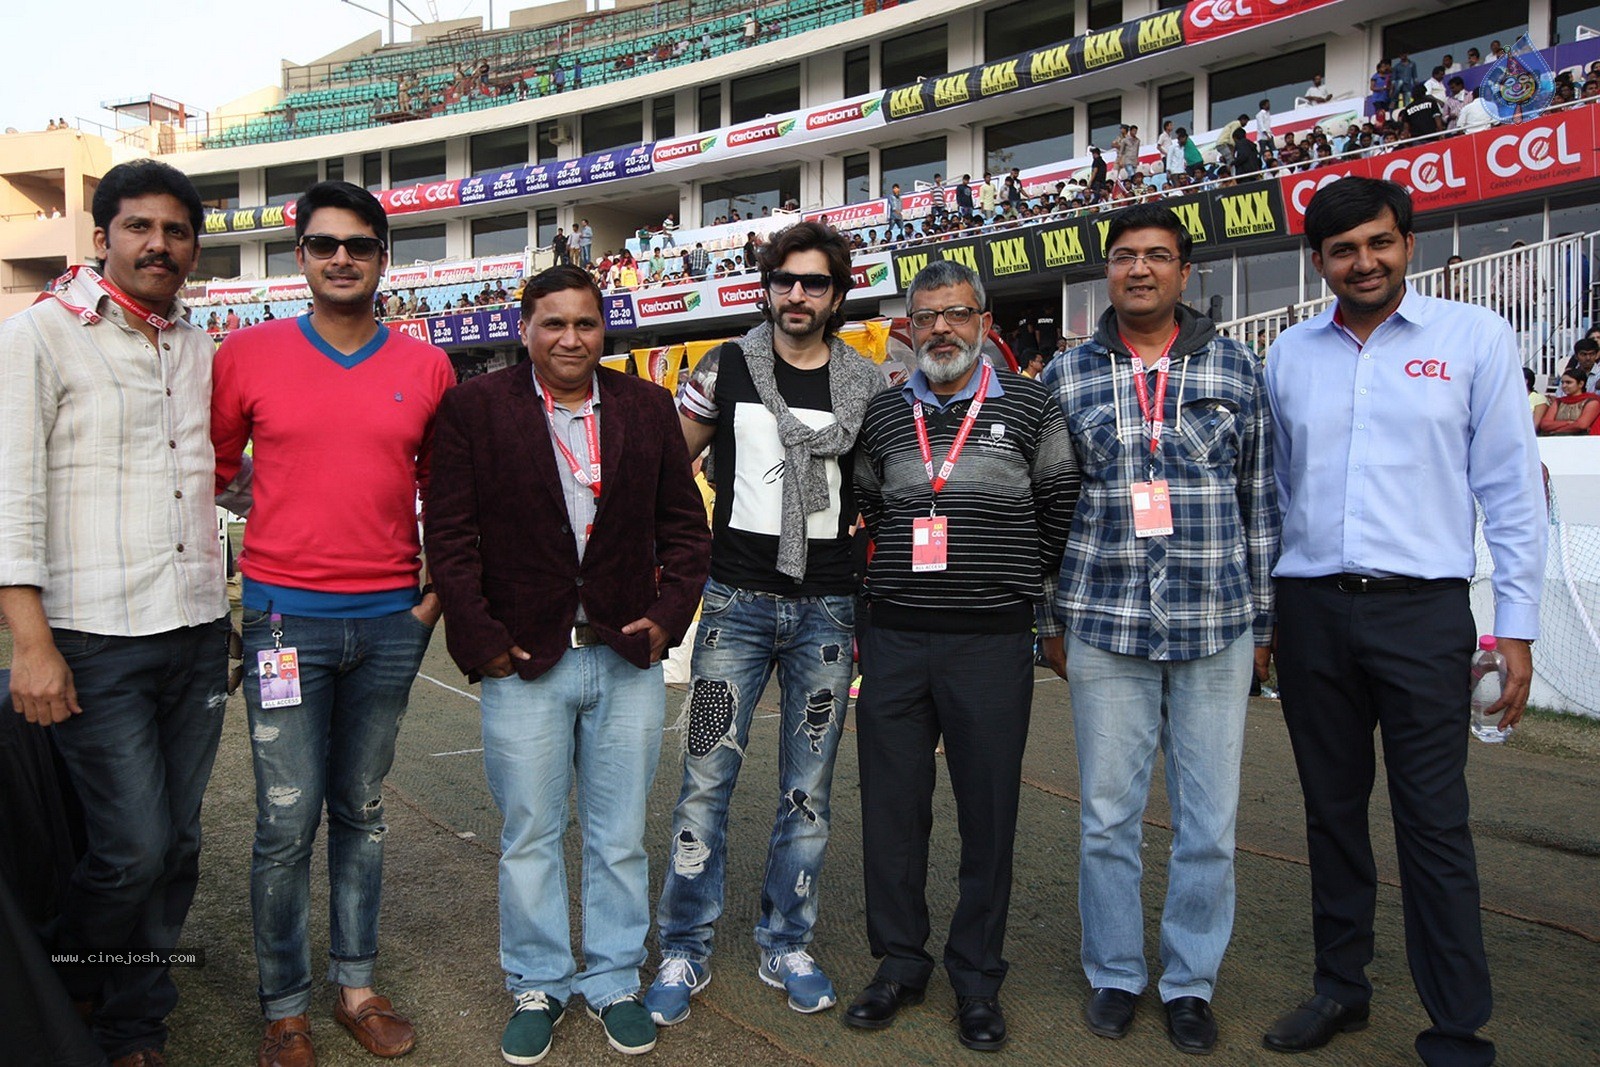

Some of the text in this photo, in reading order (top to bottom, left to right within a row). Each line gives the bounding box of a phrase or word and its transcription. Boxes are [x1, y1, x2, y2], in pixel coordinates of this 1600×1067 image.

[810, 108, 858, 126] Karbonn
[729, 127, 776, 144] Karbonn
[656, 143, 698, 160] Karbonn
[1486, 121, 1580, 178] CCL
[625, 154, 649, 166] 20-20
[557, 167, 580, 178] 20-20
[590, 161, 614, 173] 20-20
[626, 164, 650, 174] cookies
[525, 172, 548, 184] 20-20
[558, 176, 582, 186] cookies
[590, 170, 616, 180] cookies
[462, 184, 484, 196] 20-20
[493, 178, 516, 190] 20-20
[526, 182, 549, 192] cookies
[390, 188, 420, 207] CCL
[425, 183, 456, 202] CCL
[462, 193, 485, 202] cookies
[494, 188, 518, 197] cookies
[1221, 190, 1274, 227] XXX
[1227, 222, 1274, 236] ENERGY DRINK
[1041, 226, 1084, 258] XXX
[990, 237, 1029, 267] XXX
[1047, 254, 1084, 266] ENERGY DRINK
[994, 263, 1028, 274] ENERGY DRINK
[610, 308, 630, 318] 20-20
[641, 300, 682, 314] Karbonn
[488, 322, 508, 331] 20-20
[610, 318, 632, 326] cookies
[434, 328, 452, 337] 20-20
[461, 325, 479, 334] 20-20
[489, 330, 509, 338] cookies
[1132, 357, 1142, 372] CCL
[1404, 359, 1451, 380] CCL
[591, 465, 600, 480] CCL
